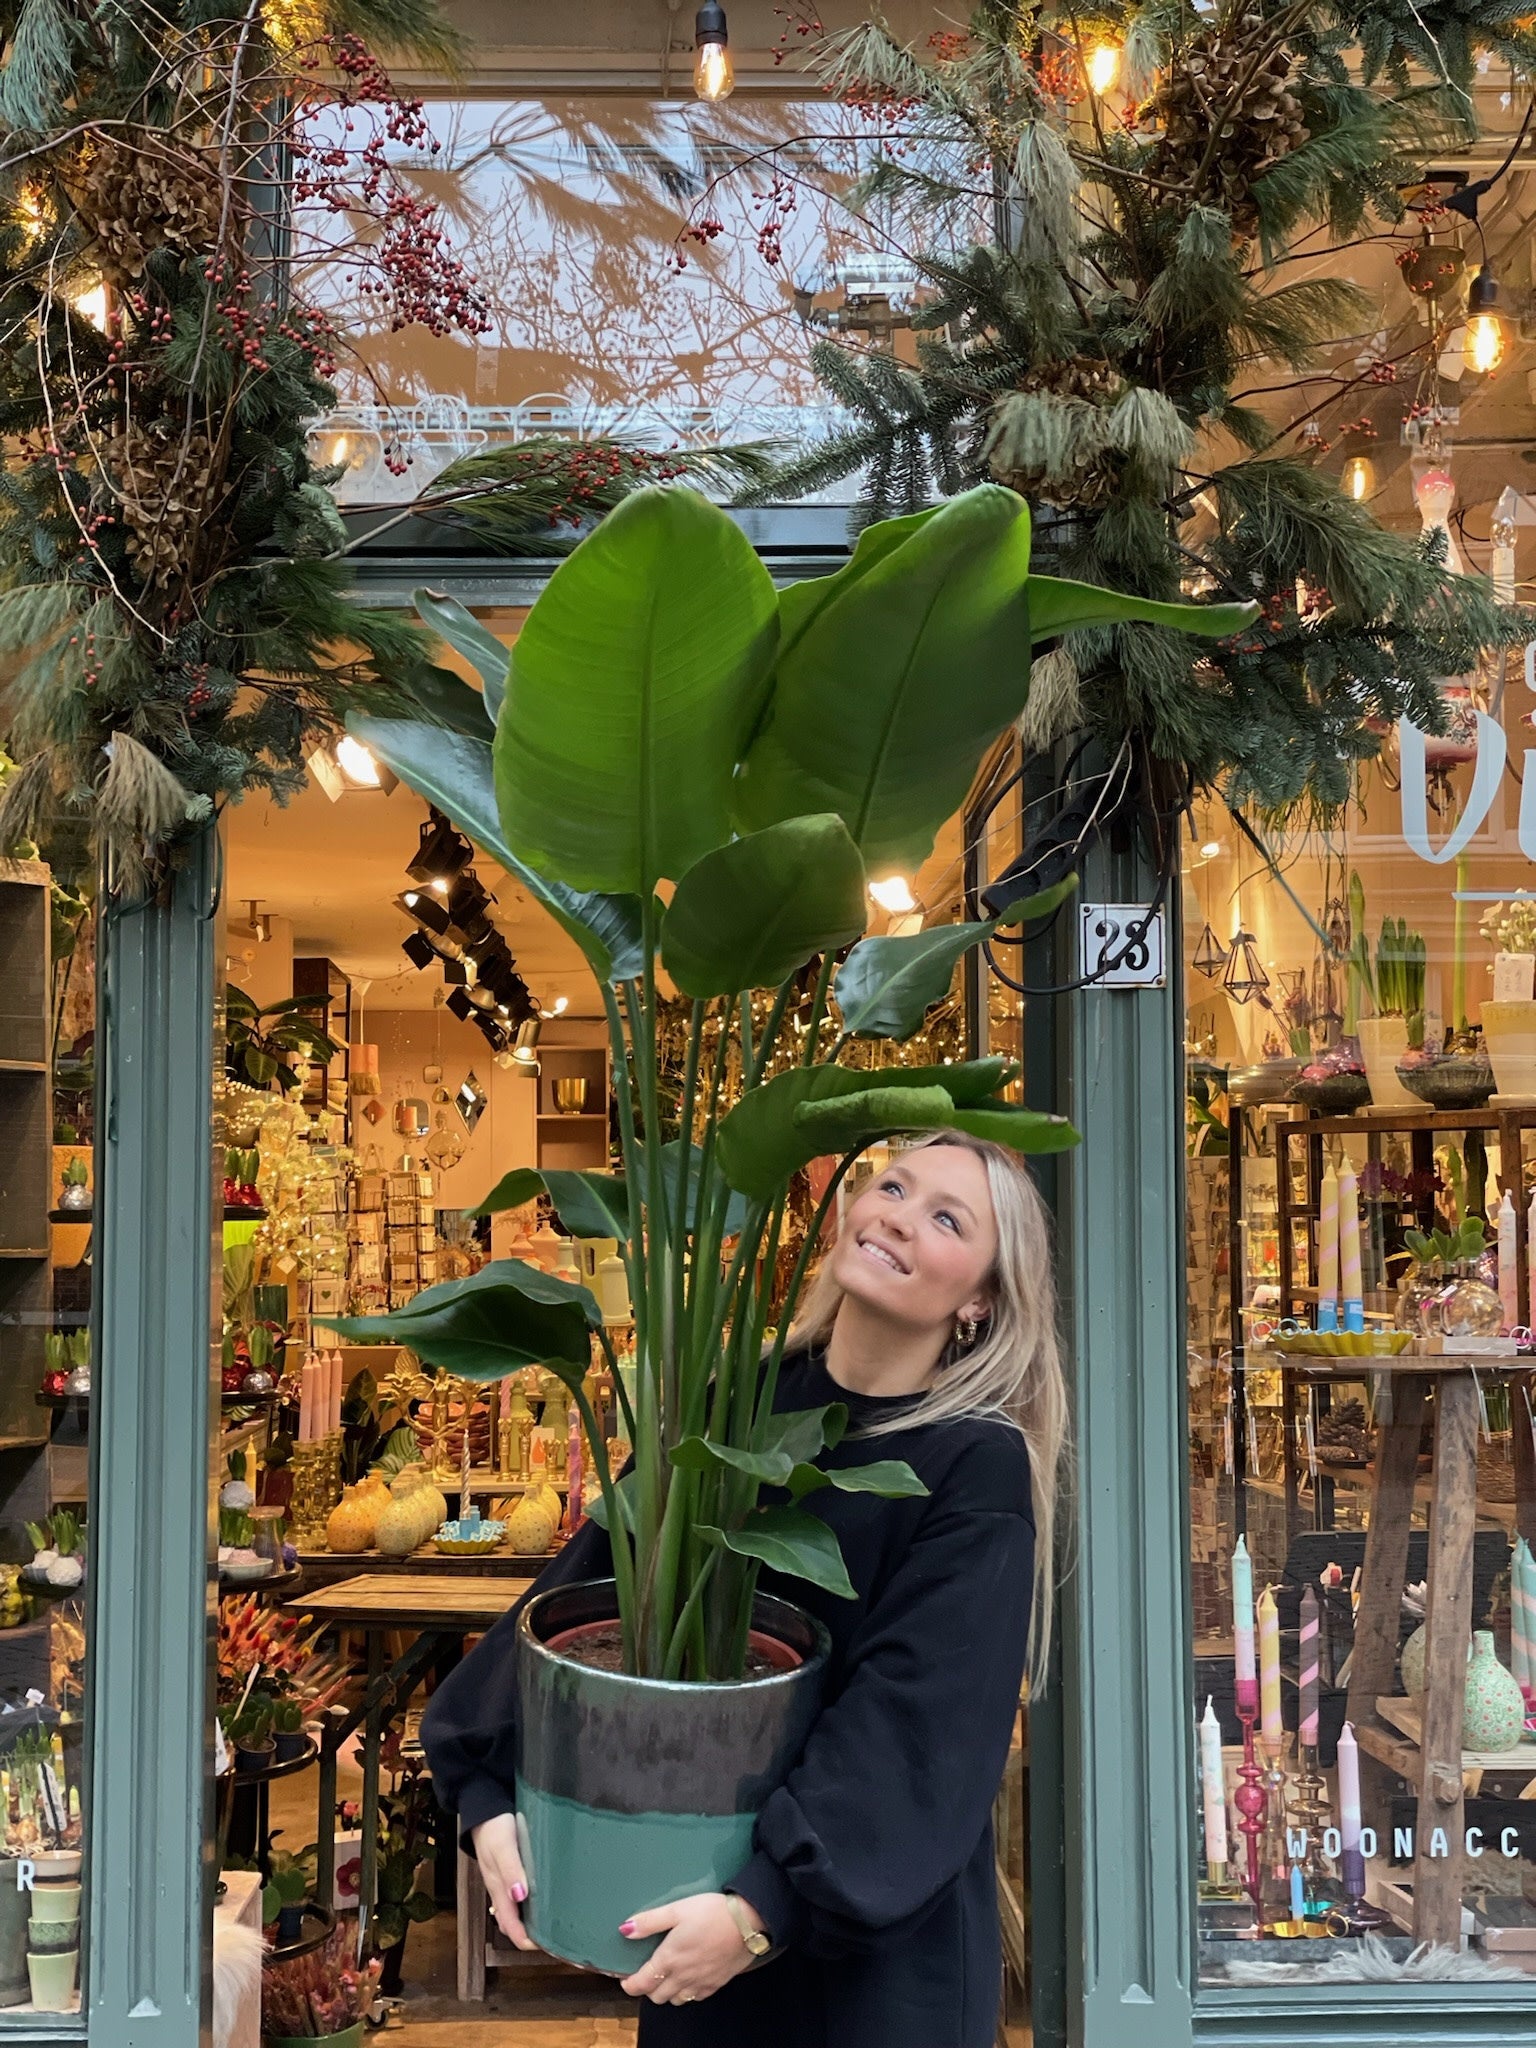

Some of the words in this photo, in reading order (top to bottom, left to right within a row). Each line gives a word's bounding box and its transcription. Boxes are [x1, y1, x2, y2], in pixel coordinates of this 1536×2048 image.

[1095, 919, 1150, 972] 23
[1286, 1827, 1519, 1858] WOONACC
[17, 1860, 37, 1892] R
